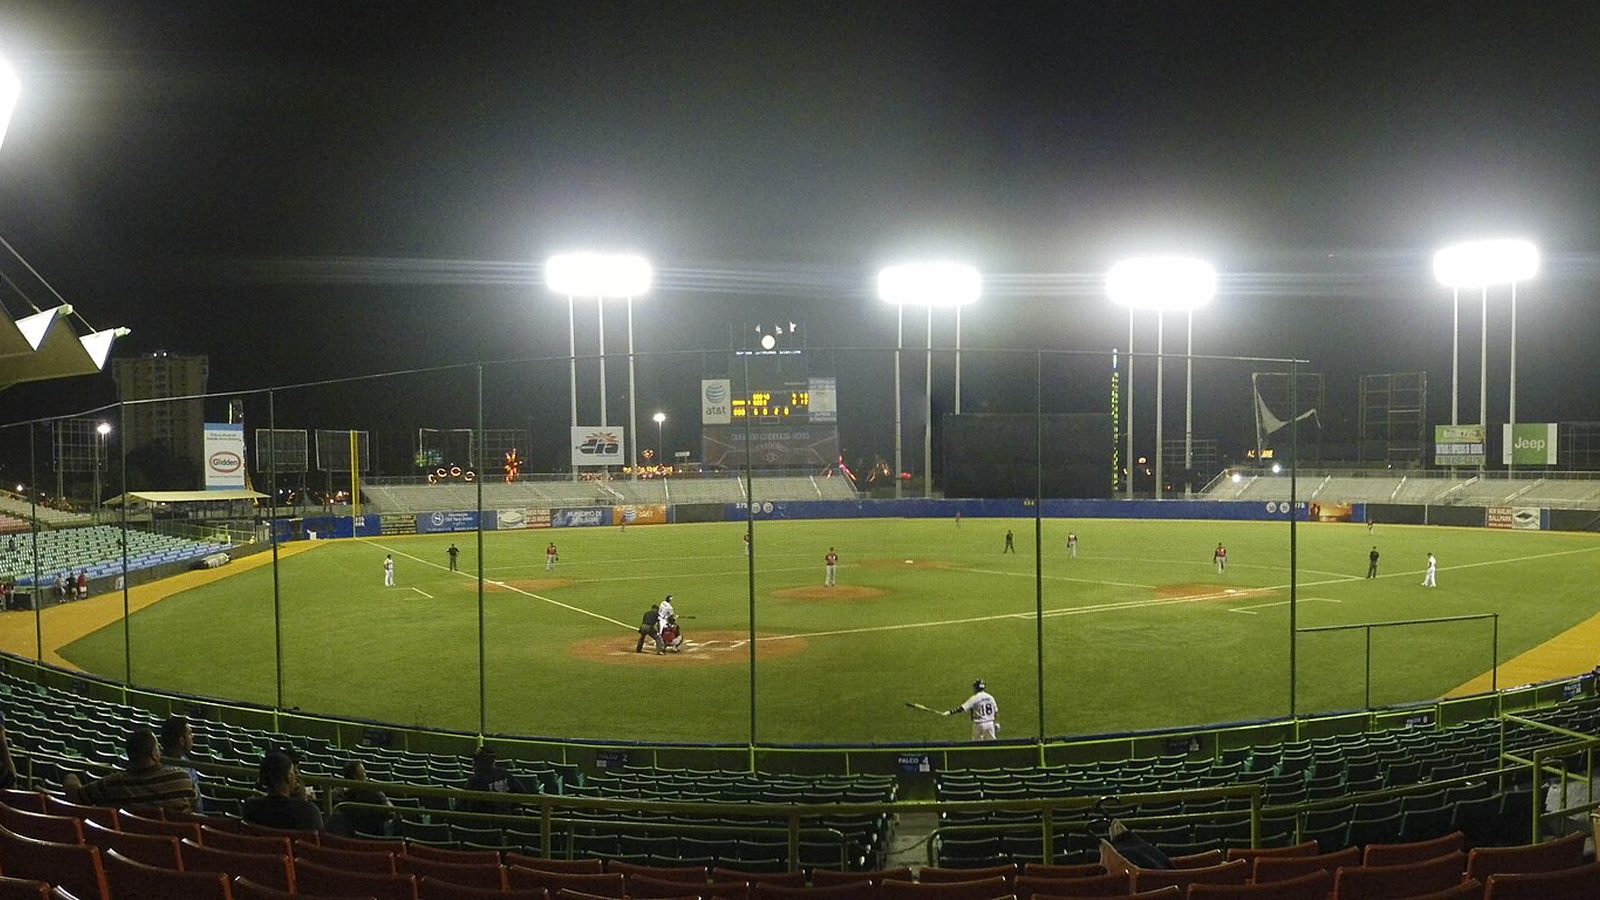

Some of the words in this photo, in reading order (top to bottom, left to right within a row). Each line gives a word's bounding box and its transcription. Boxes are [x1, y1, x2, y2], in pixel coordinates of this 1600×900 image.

[706, 406, 727, 415] at&t
[1514, 437, 1545, 451] Jeep
[213, 458, 237, 466] Glidden
[980, 703, 993, 717] 18
[922, 756, 929, 764] 4
